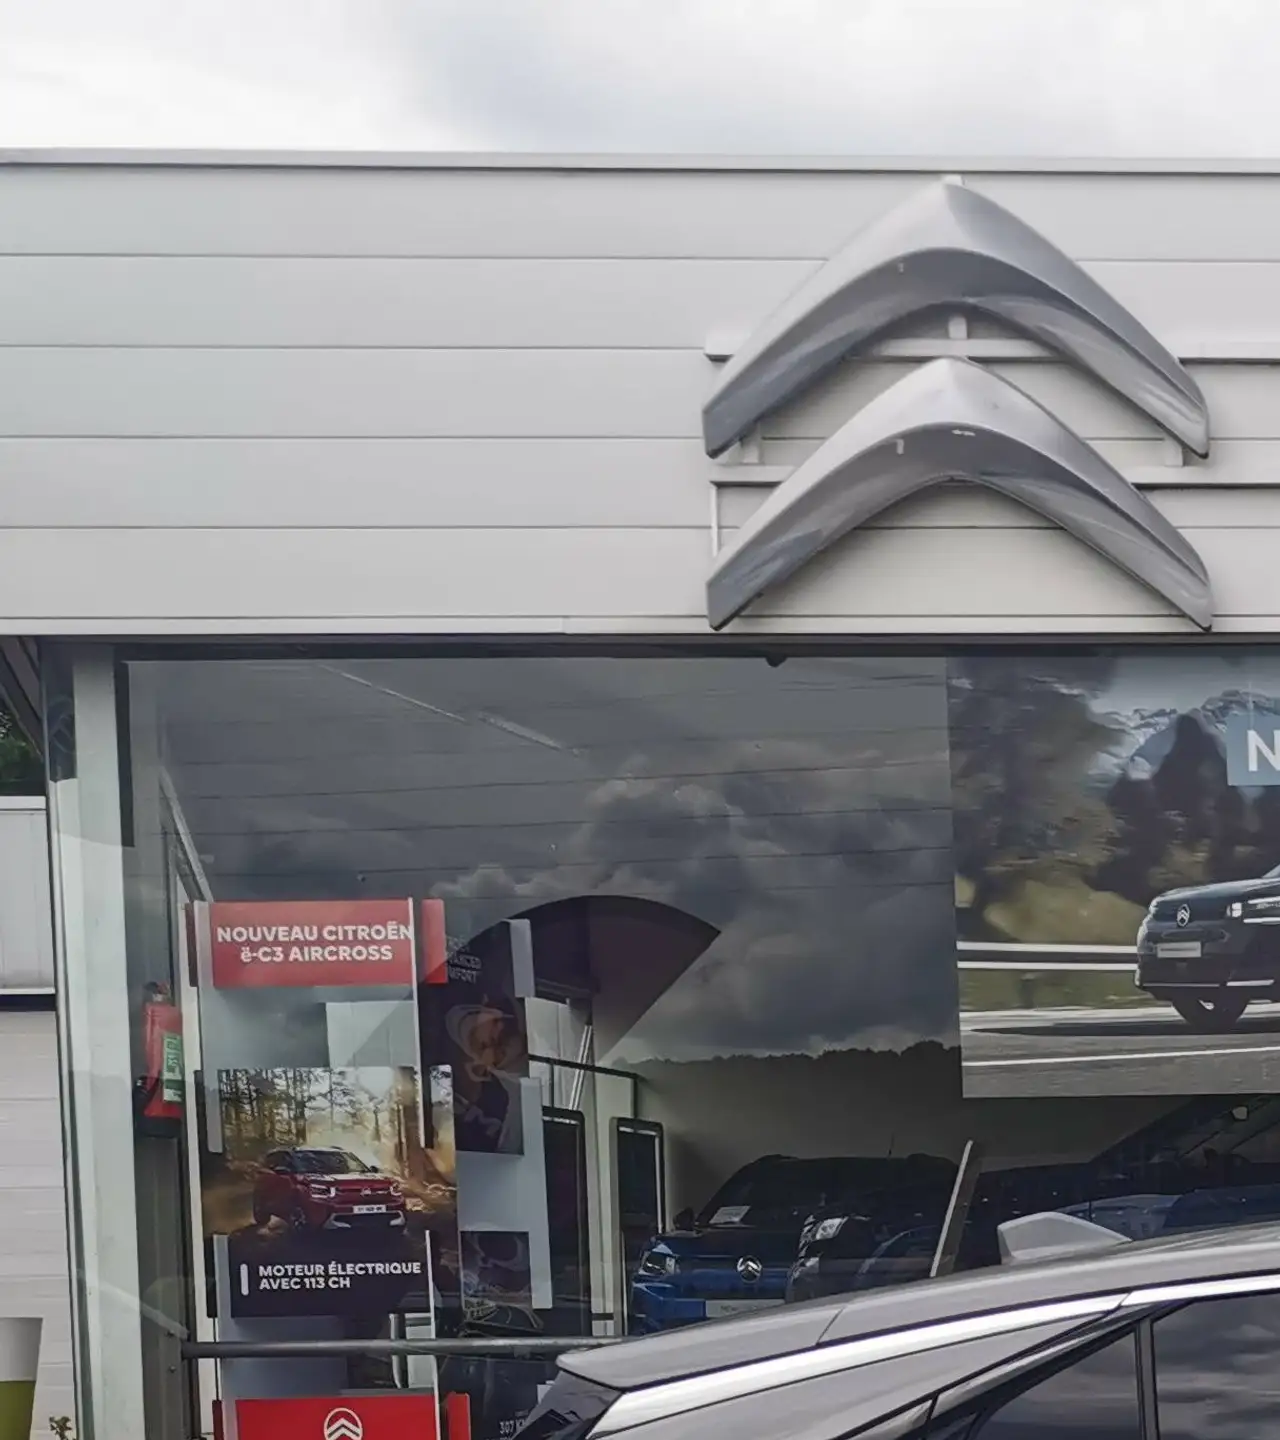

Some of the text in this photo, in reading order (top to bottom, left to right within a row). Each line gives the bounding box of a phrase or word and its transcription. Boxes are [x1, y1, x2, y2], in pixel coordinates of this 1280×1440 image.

[217, 921, 413, 943] NOUVEAU CITROËN
[240, 945, 393, 963] ë-C3 AIRCROSS
[258, 1261, 422, 1277] MOTEUR ÉLECTRIQUE
[259, 1277, 351, 1290] AVEC 113 CH
